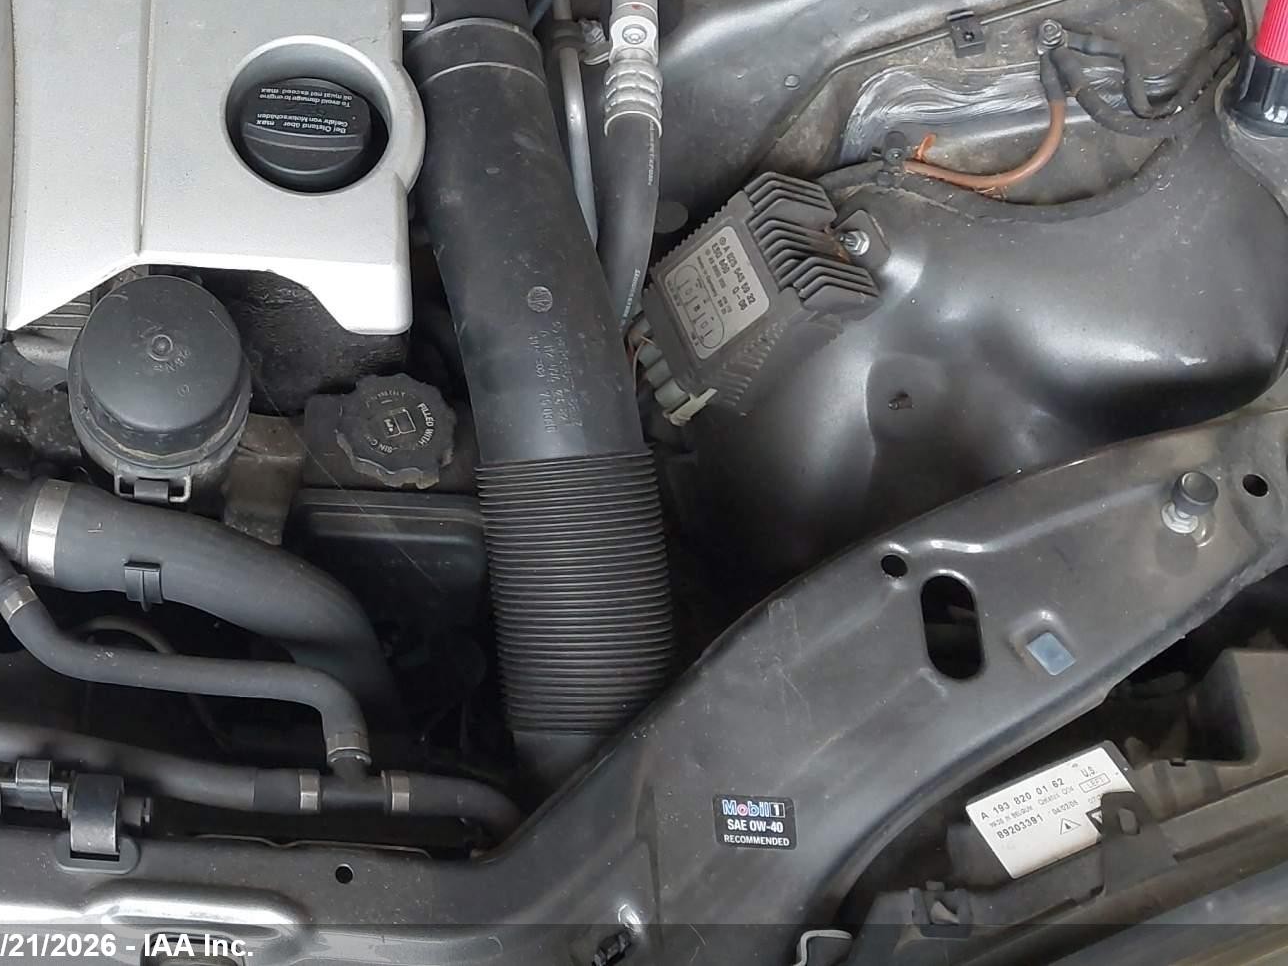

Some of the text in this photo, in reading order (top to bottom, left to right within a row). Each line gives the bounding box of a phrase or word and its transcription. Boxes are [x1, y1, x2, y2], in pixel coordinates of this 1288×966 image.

[417, 402, 434, 446] FILLED WITH
[980, 811, 989, 820] A
[993, 802, 1010, 814] 193
[1013, 792, 1032, 805] 820
[1036, 785, 1048, 795] 01
[1052, 778, 1065, 788] 62
[722, 800, 769, 817] Mobil
[727, 819, 784, 833] SAE 0W-40
[724, 835, 790, 847] RECOMMENDED
